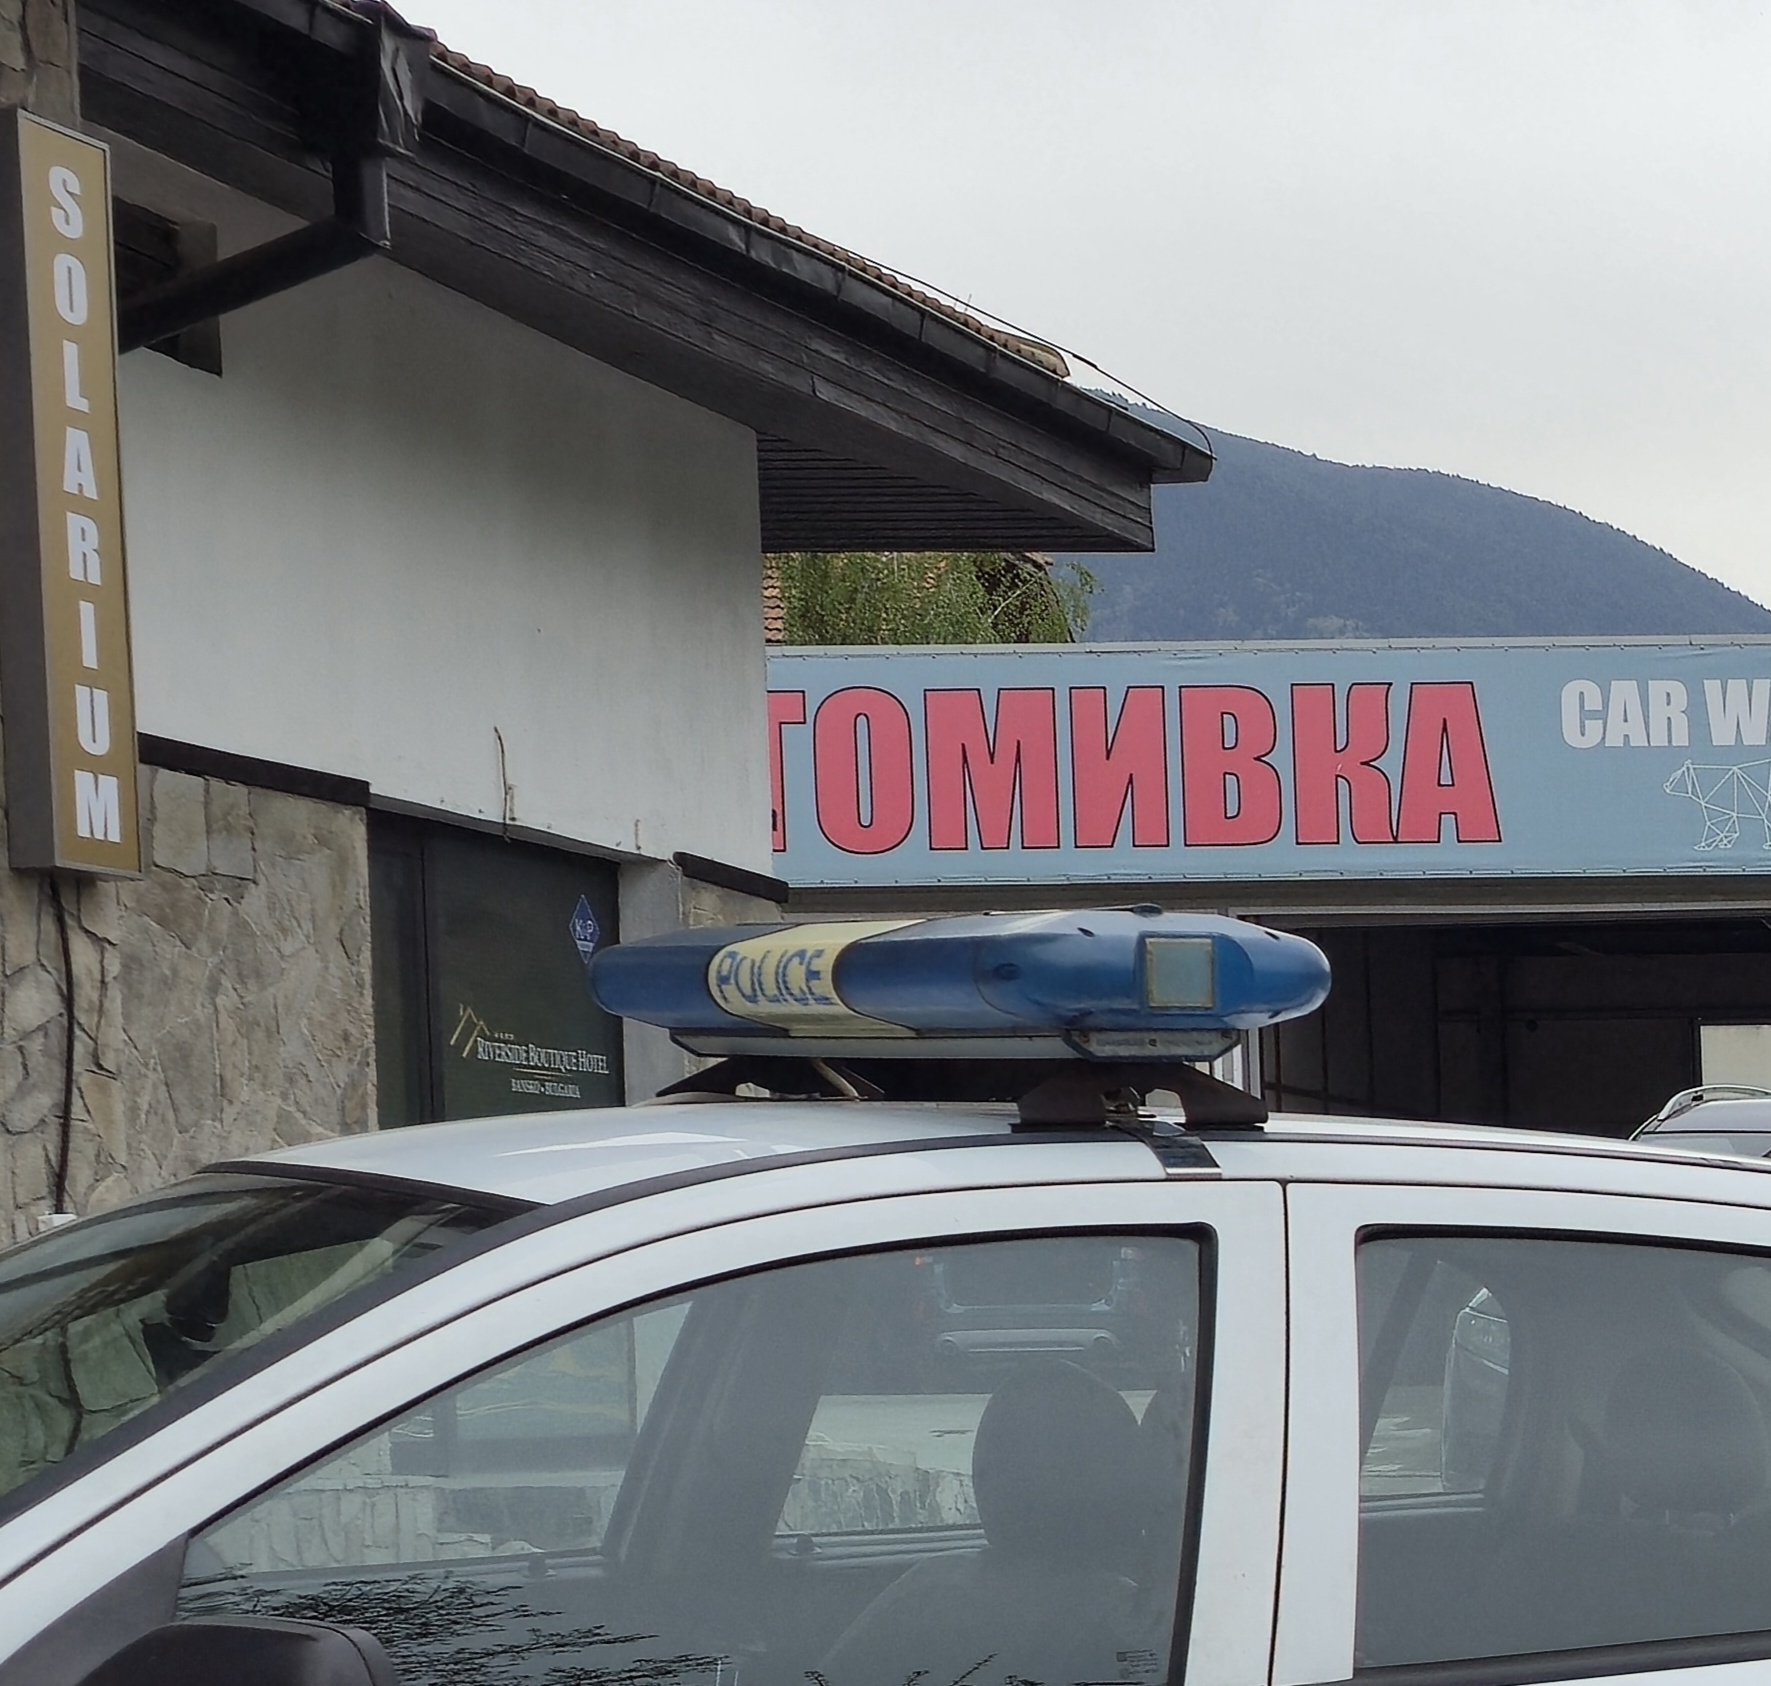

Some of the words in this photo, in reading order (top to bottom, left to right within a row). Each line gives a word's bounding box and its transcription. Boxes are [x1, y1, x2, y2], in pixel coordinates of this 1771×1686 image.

[49, 166, 121, 843] SOLARIUM
[1561, 678, 1690, 748] CAR
[716, 948, 838, 1006] POLICE
[578, 1050, 609, 1074] HOTEL
